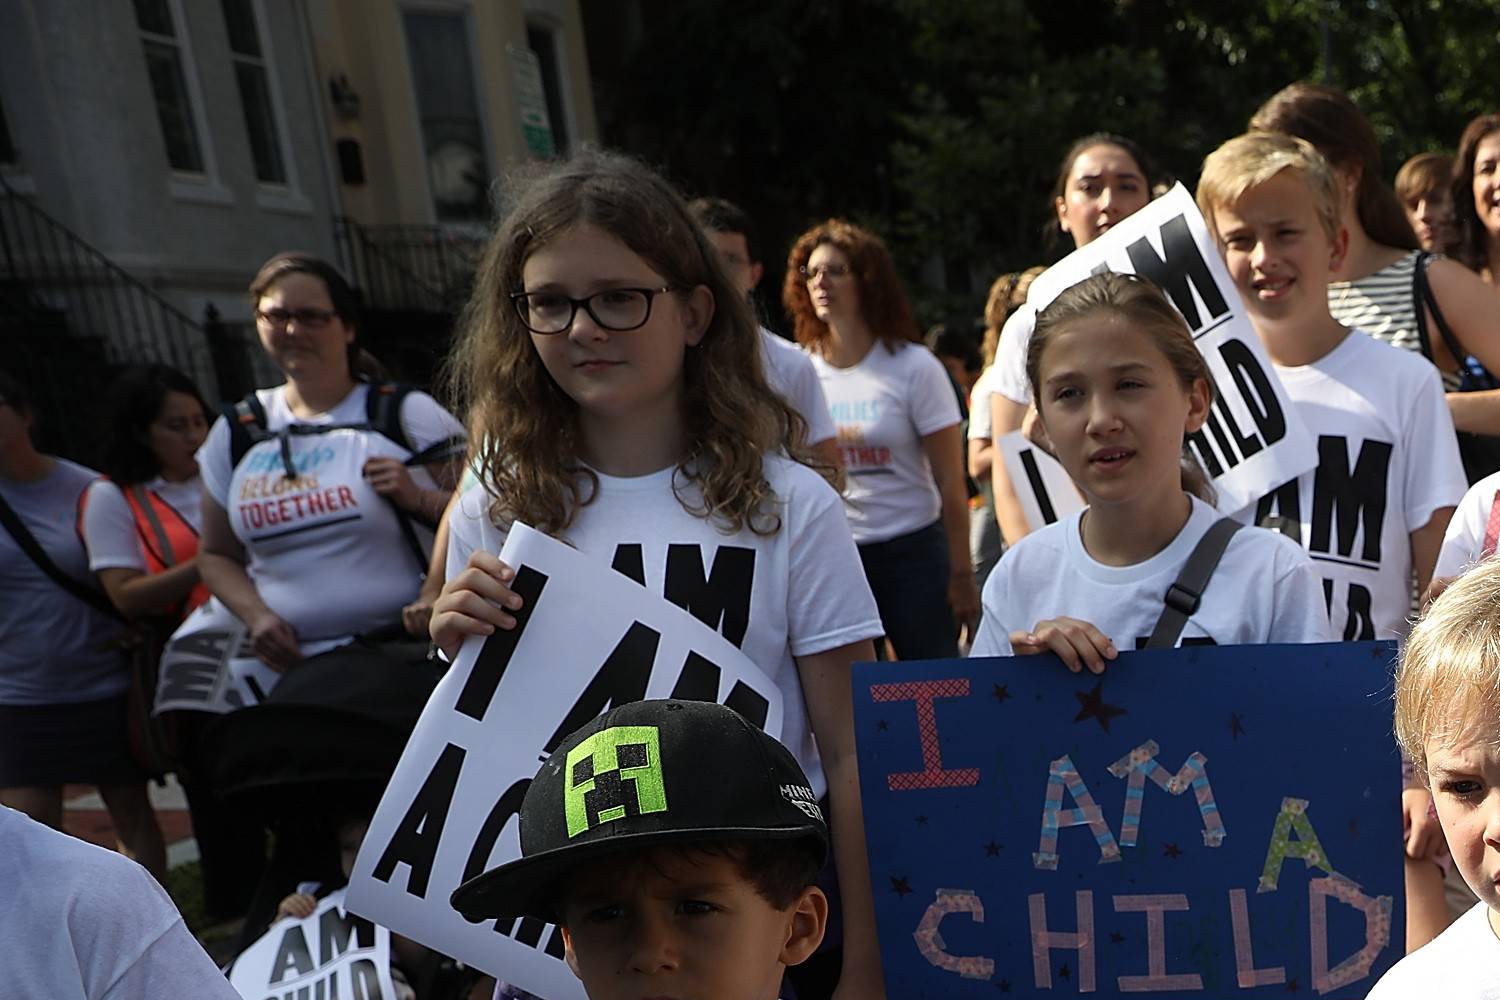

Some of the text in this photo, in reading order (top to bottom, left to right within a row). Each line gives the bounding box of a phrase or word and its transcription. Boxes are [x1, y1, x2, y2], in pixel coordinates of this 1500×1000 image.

[1093, 213, 1231, 332] M
[1184, 338, 1287, 478] ILD
[238, 484, 358, 530] TOGETHER
[454, 563, 549, 721] I
[611, 543, 757, 651] M
[371, 742, 467, 900] A
[870, 679, 1334, 894] I AM A
[269, 905, 377, 985] AM
[913, 872, 1394, 996] CHILD
